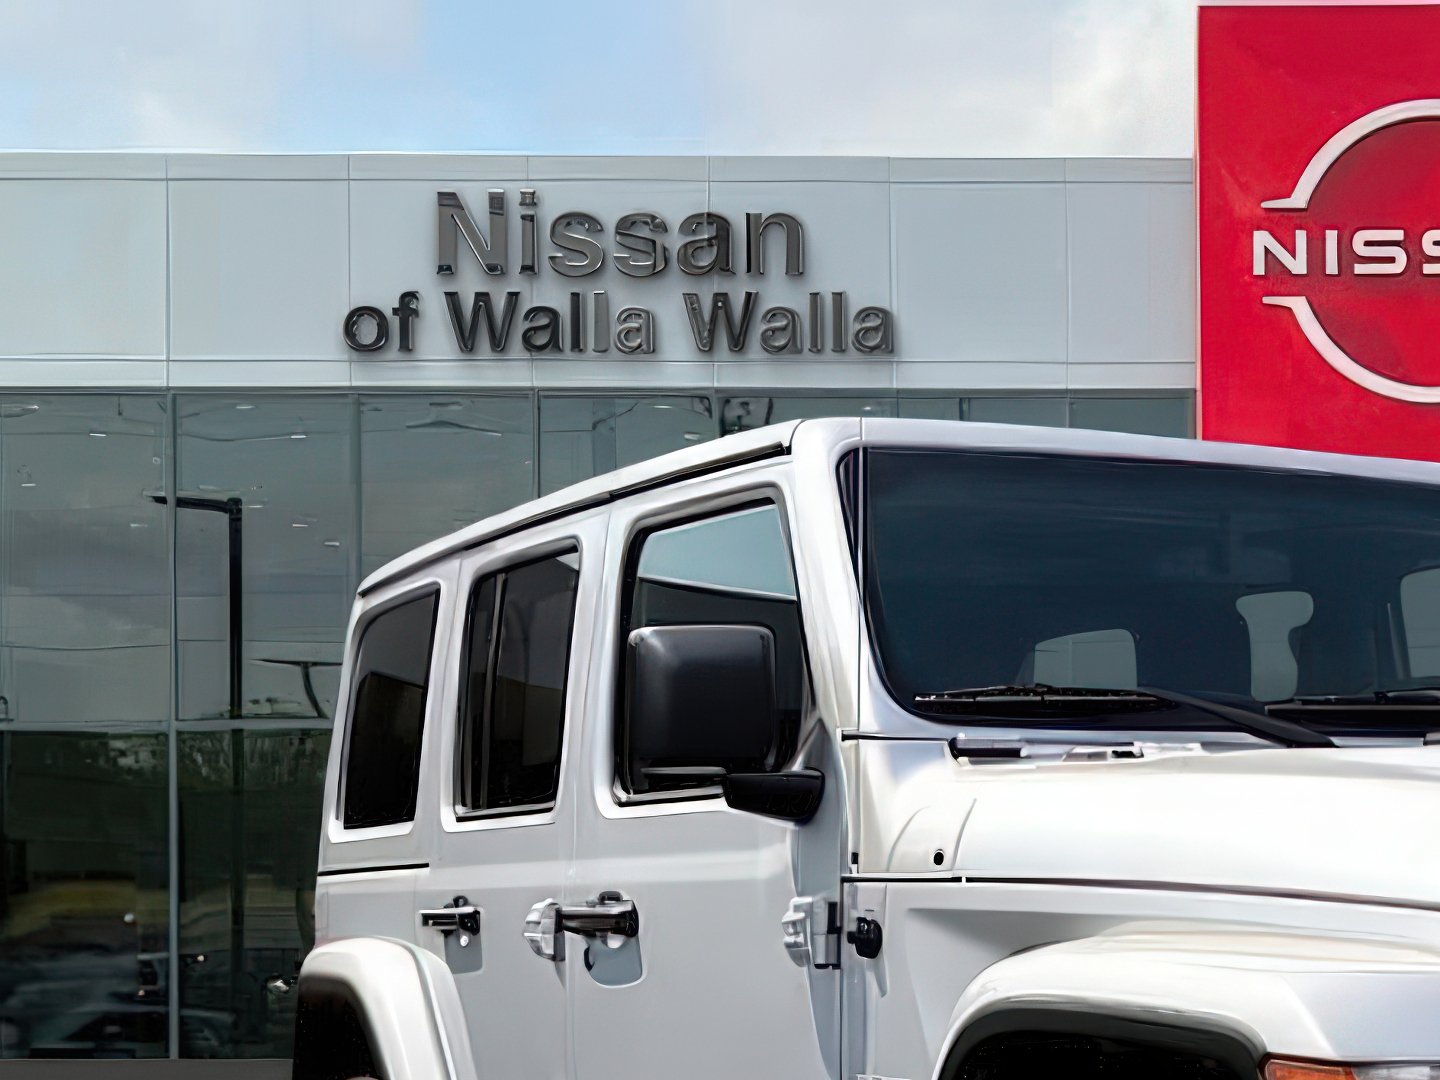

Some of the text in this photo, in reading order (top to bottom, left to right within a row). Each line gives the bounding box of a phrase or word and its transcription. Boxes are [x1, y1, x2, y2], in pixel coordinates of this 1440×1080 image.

[436, 188, 805, 276] Nissan
[342, 290, 895, 354] of Walla Walla
